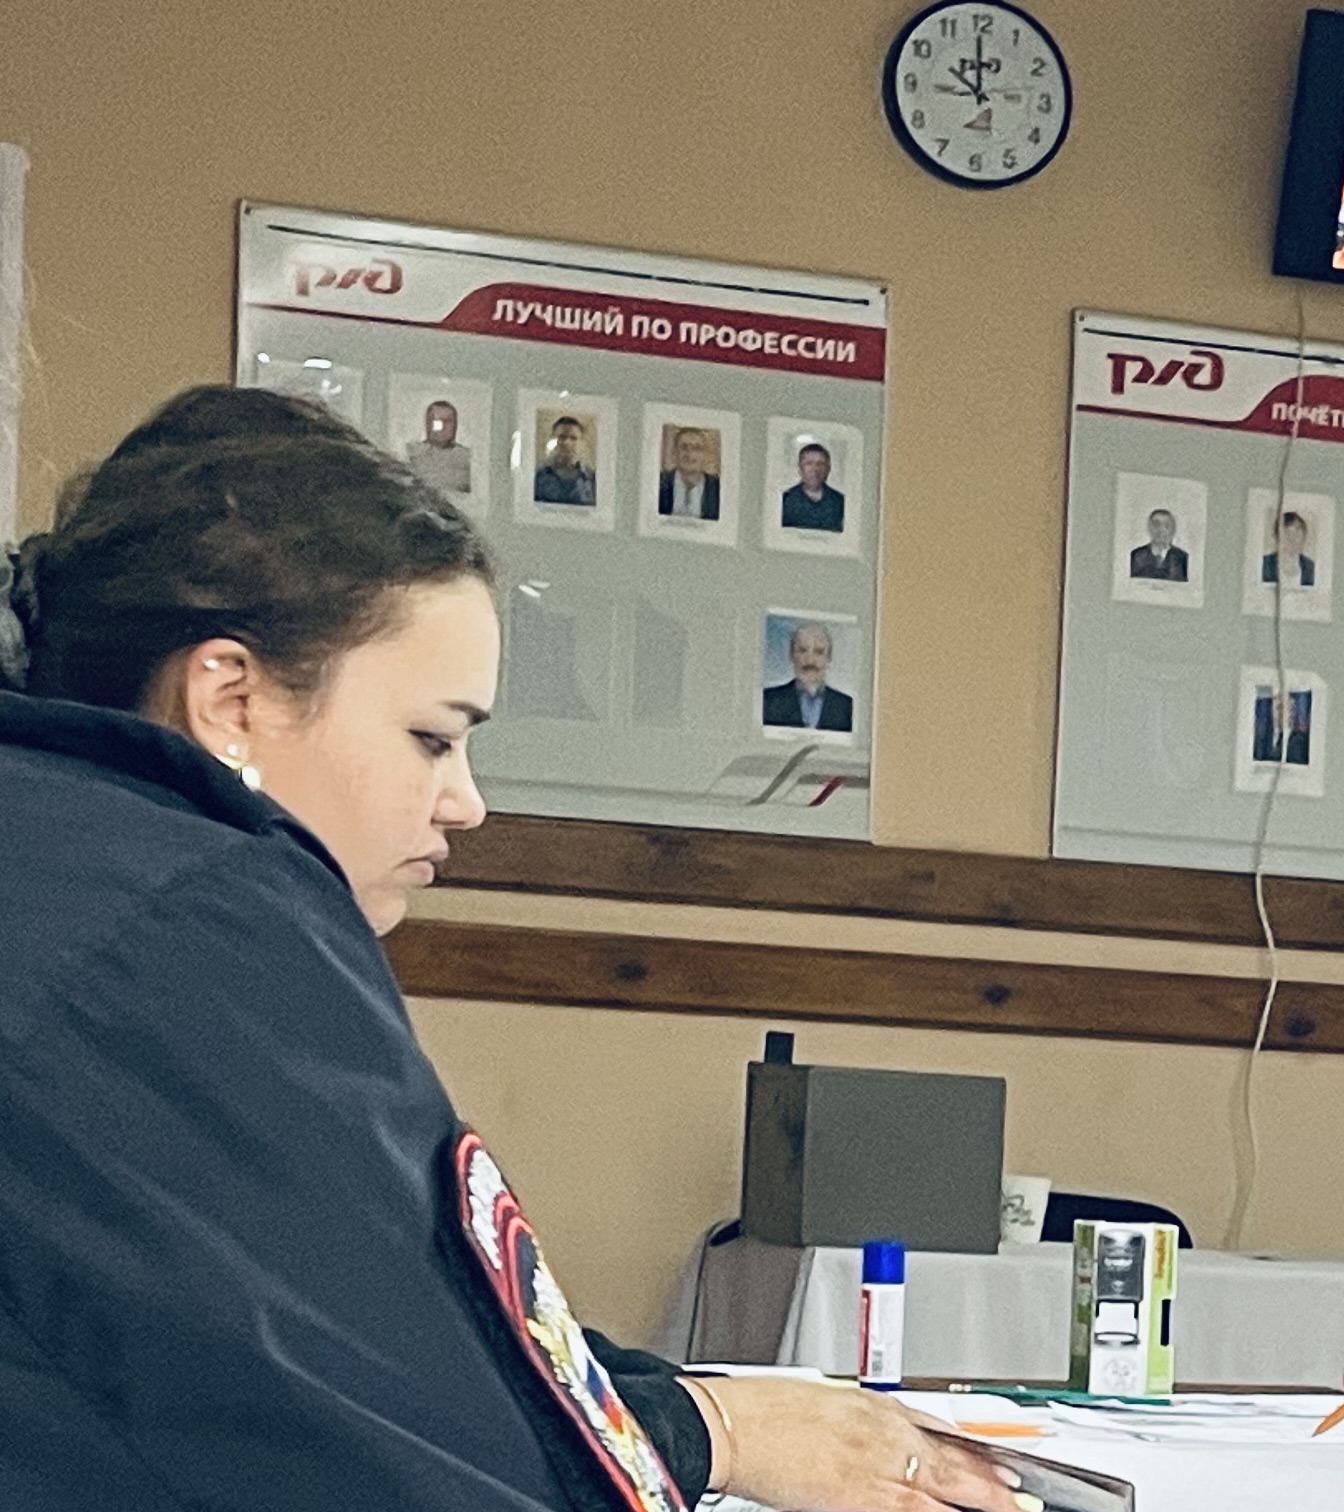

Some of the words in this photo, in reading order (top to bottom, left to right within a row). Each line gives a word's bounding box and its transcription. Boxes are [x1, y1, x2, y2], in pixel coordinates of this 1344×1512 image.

[939, 17, 957, 38] 11
[972, 14, 993, 34] 12
[1012, 29, 1020, 46] 1
[912, 39, 931, 59] 10
[1030, 57, 1047, 77] 2
[904, 72, 917, 93] 9
[1037, 93, 1051, 113] 3
[911, 109, 925, 129] 8
[1028, 127, 1040, 144] 4
[934, 138, 950, 156] 7
[969, 153, 982, 172] 6
[1003, 149, 1017, 170] 5
[492, 299, 624, 336] ЛУЧШИЙ
[631, 316, 673, 341] ПО
[679, 322, 857, 364] ПРОФЕССИИ
